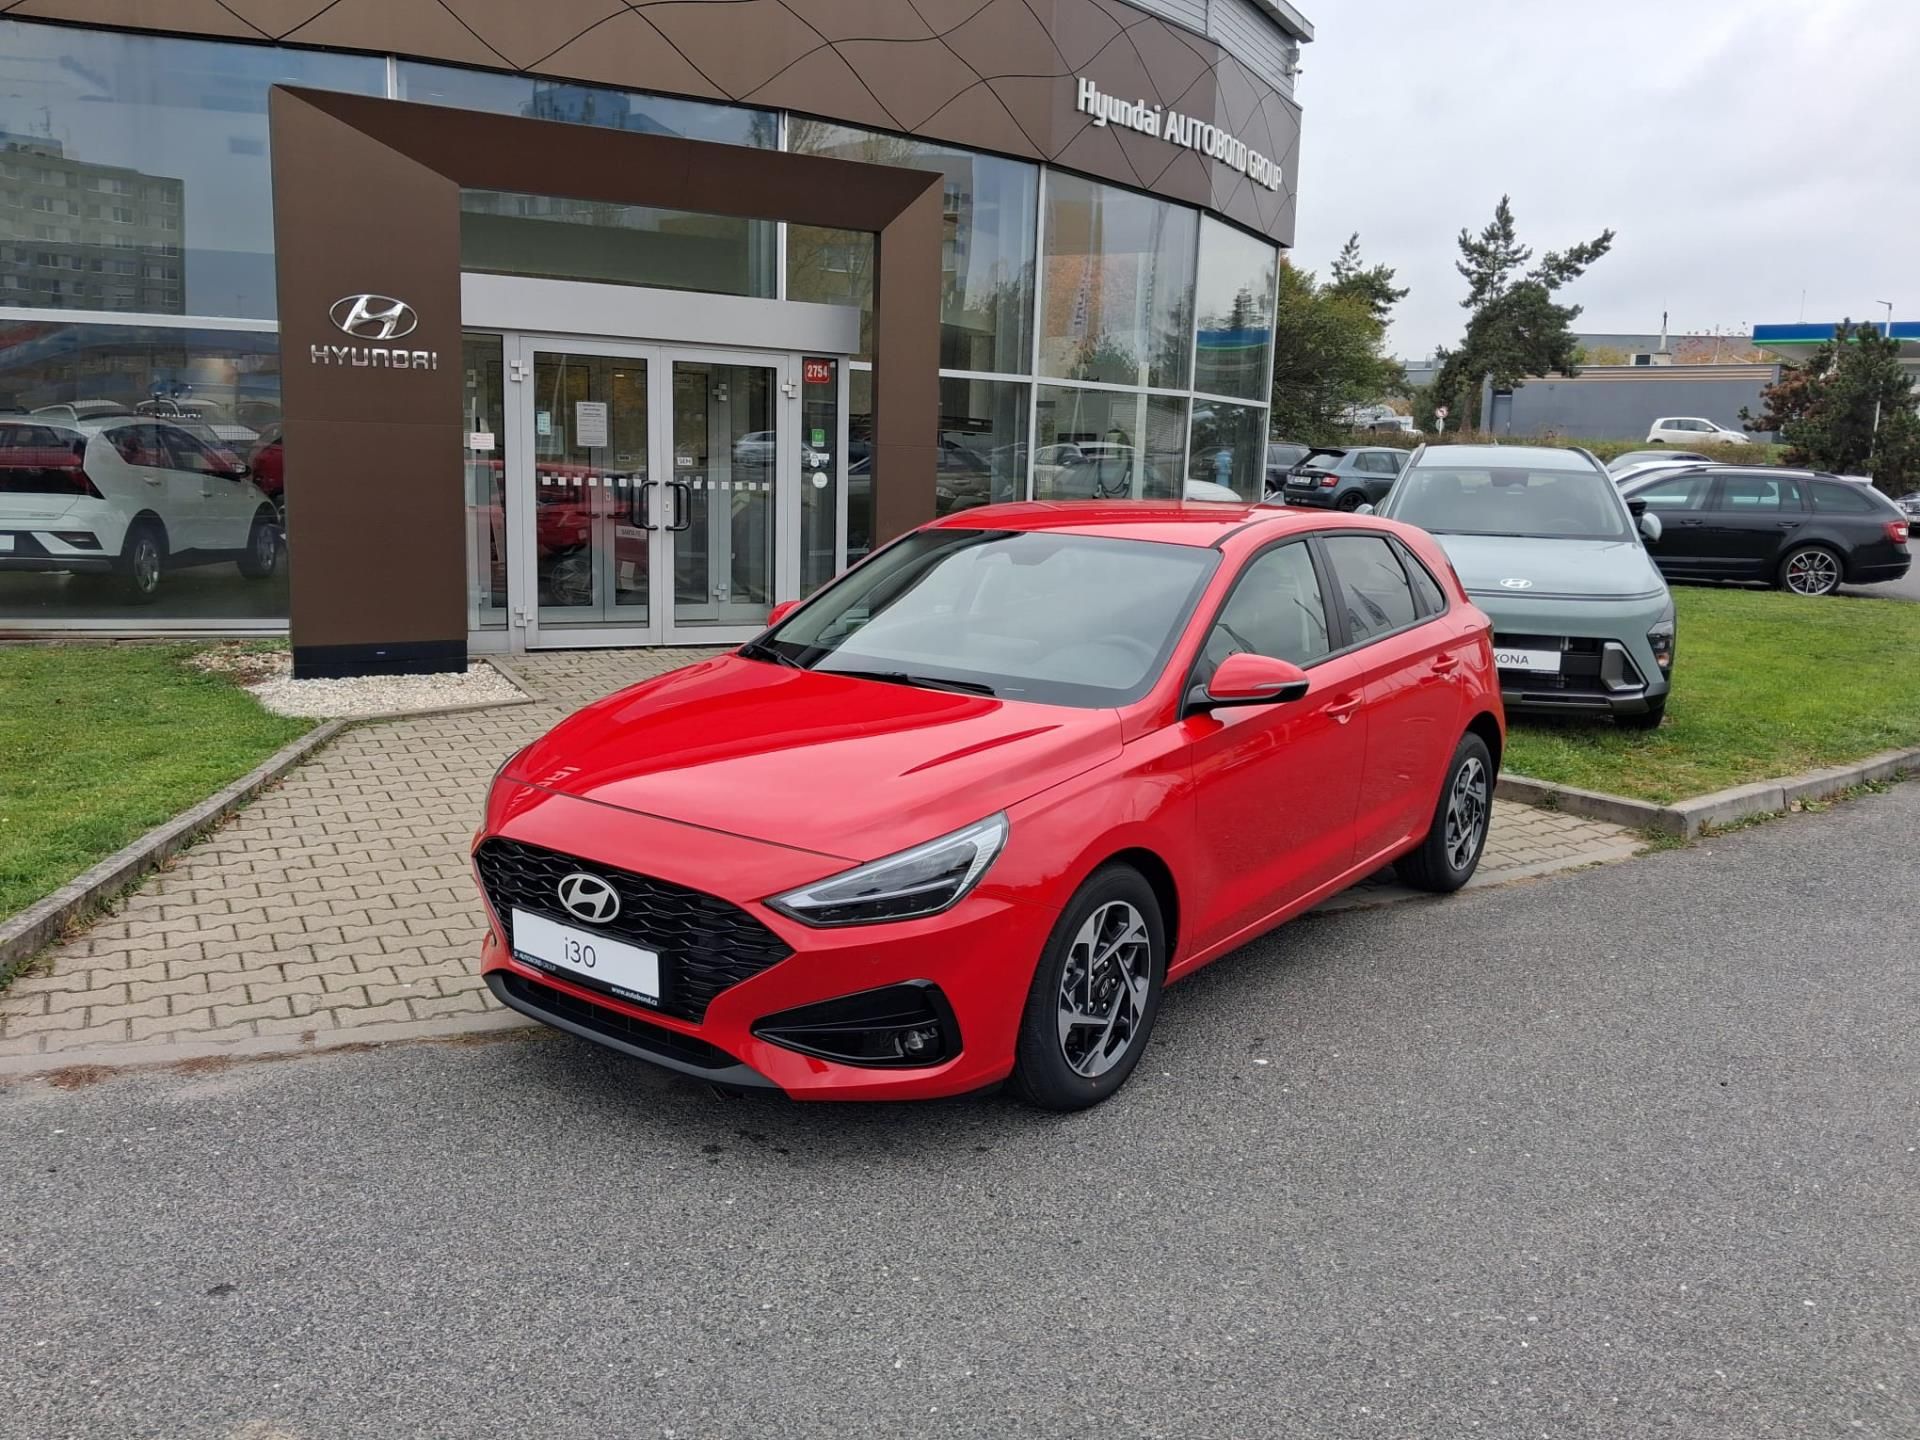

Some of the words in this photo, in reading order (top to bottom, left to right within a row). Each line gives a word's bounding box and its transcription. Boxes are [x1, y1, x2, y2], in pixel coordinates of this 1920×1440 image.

[1077, 77, 1161, 136] Hyundai
[1163, 111, 1247, 172] AUTOBOND
[1247, 149, 1282, 192] GROUP
[310, 344, 438, 370] HYUNDAI
[807, 364, 828, 378] 2754
[564, 936, 597, 968] i30
